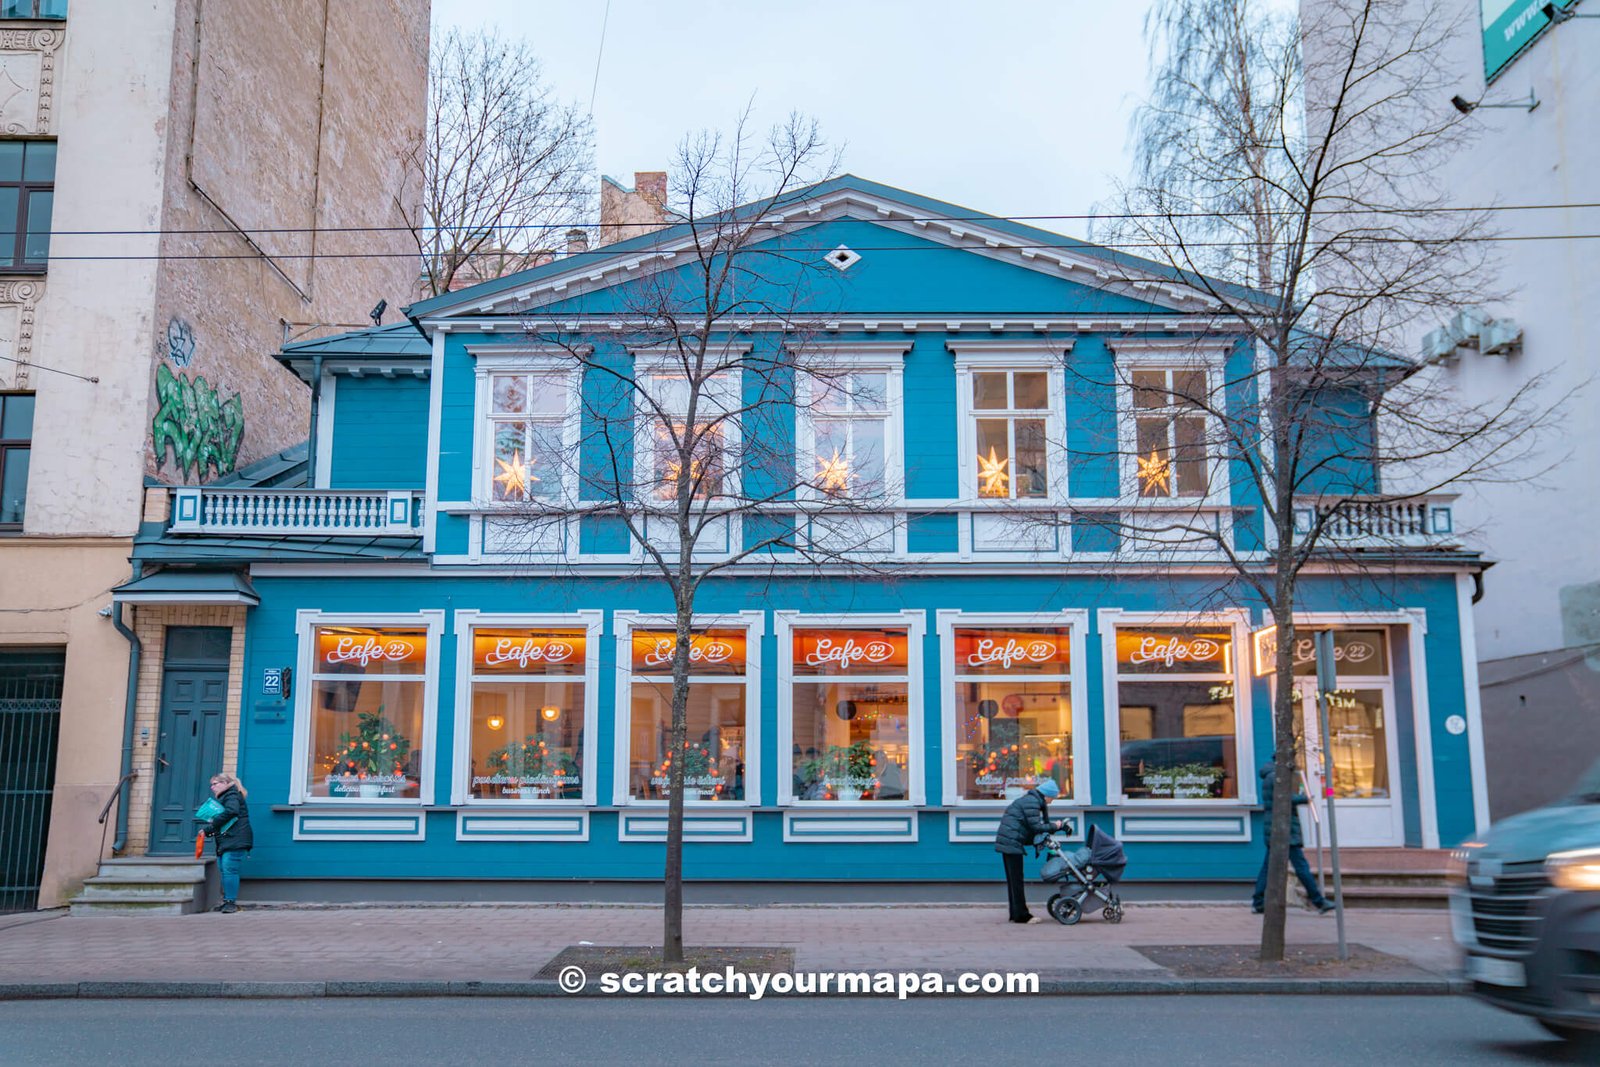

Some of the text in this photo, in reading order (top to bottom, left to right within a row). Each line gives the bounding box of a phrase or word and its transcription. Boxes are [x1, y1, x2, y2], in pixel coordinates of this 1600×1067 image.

[327, 637, 405, 667] Cafe 22
[485, 638, 564, 669] Cafe 22
[708, 646, 724, 658] 22
[806, 639, 885, 669] Cafe 22
[968, 639, 1048, 669] Cafe 22
[1130, 637, 1210, 667] Cafe 22
[1349, 646, 1366, 658] 22
[265, 676, 279, 687] 22
